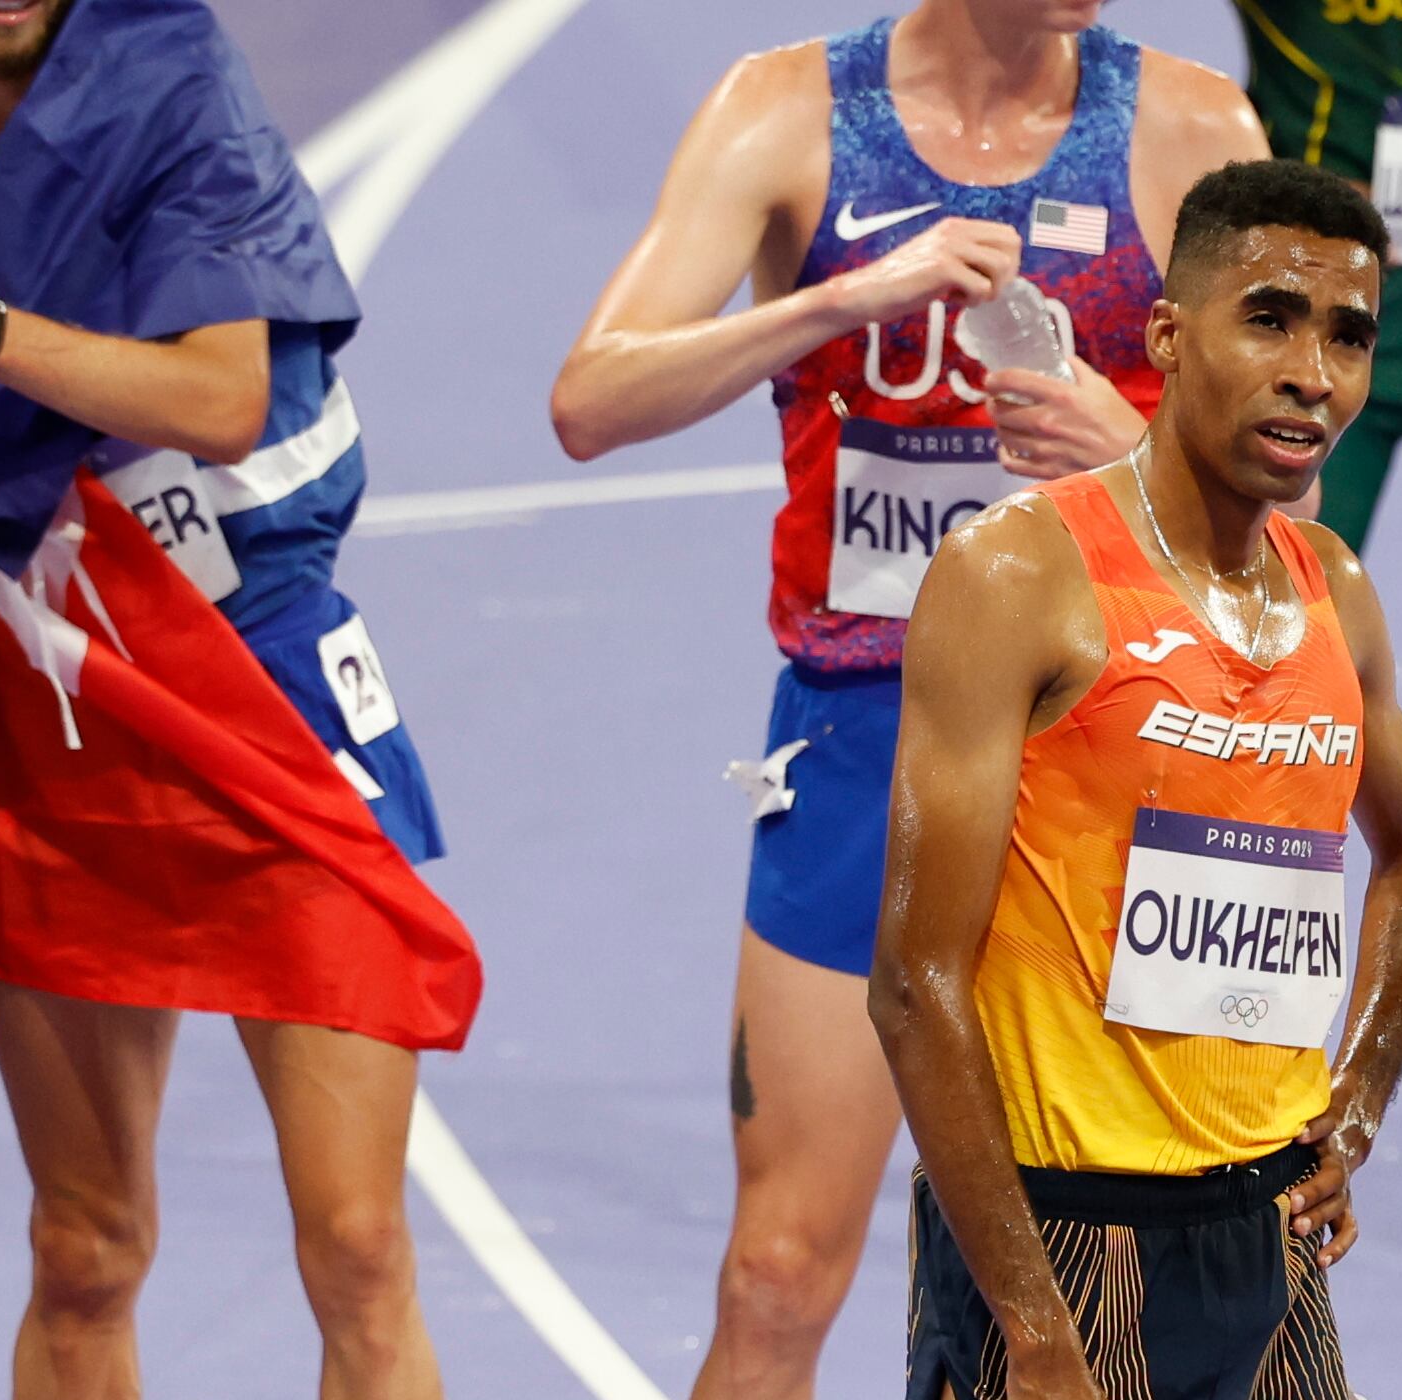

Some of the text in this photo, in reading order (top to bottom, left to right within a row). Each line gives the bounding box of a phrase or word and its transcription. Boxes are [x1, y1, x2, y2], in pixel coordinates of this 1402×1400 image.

[896, 434, 964, 454] PARIS
[1137, 700, 1357, 767] ESPAÑA
[1205, 827, 1313, 859] PARIS 2024
[1125, 889, 1342, 978] OUKHELFEN
